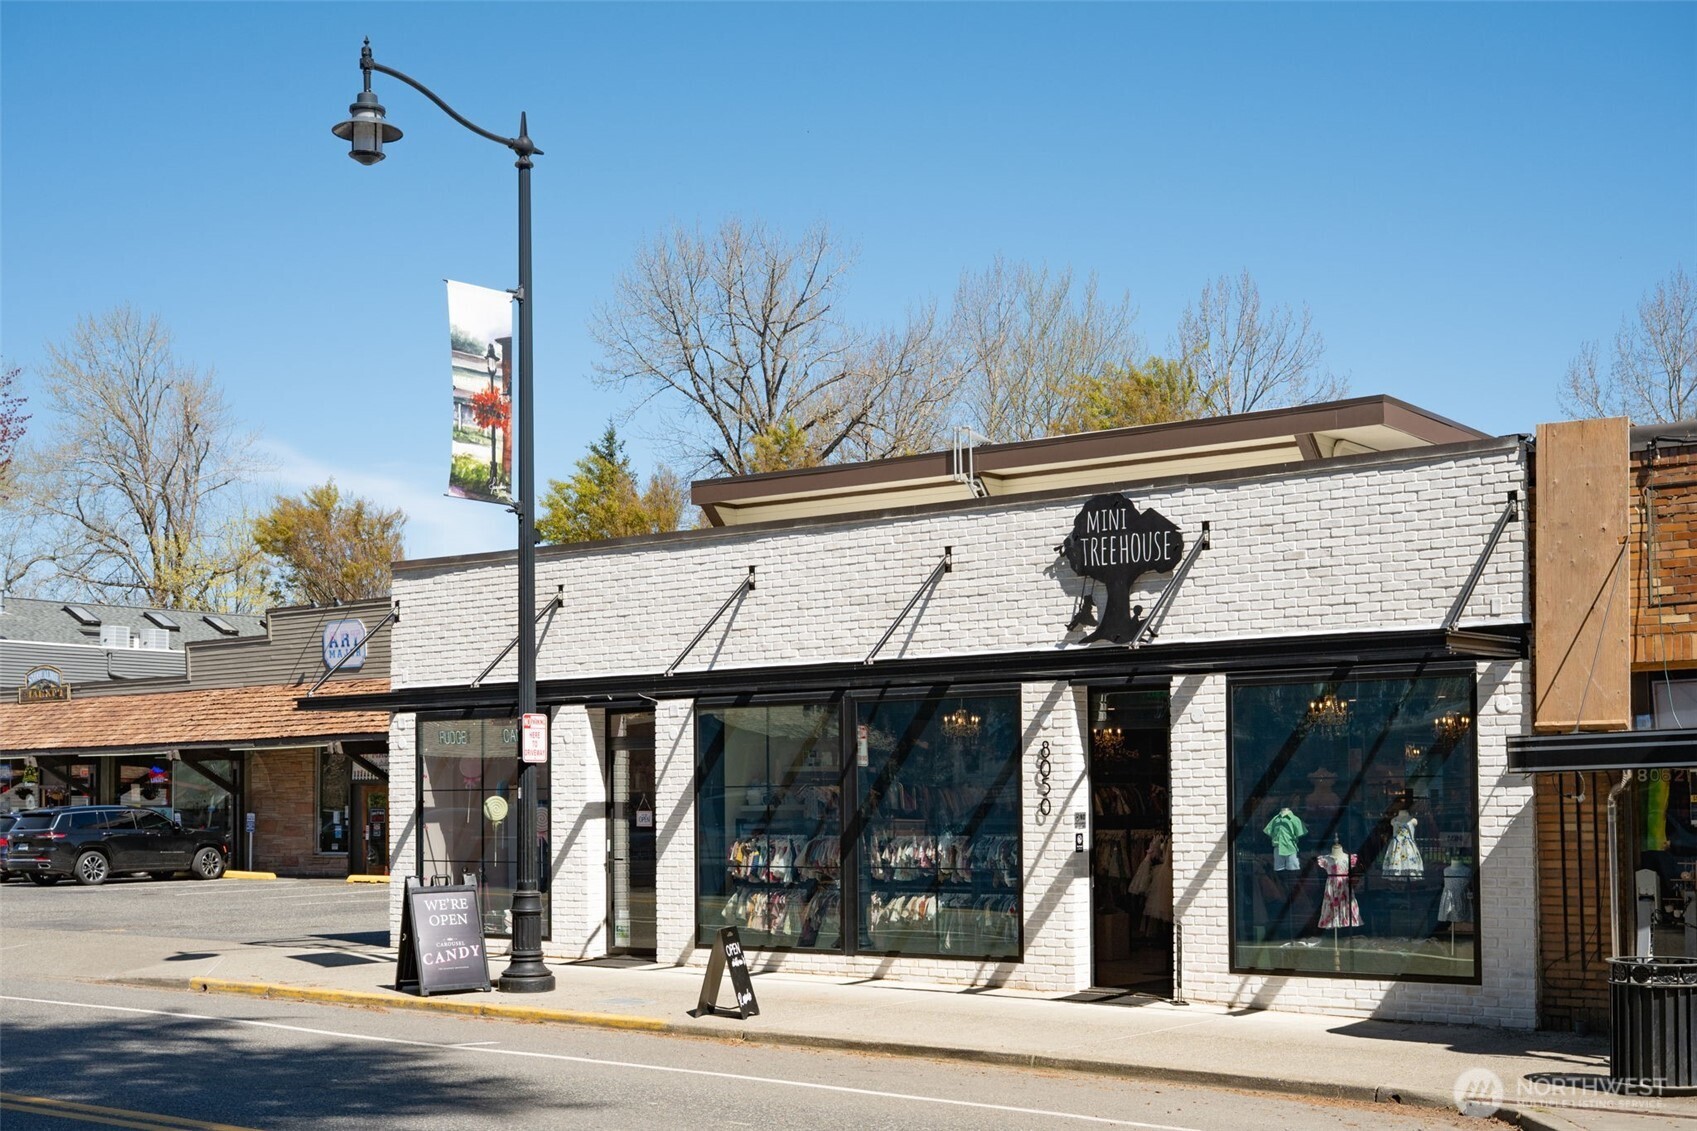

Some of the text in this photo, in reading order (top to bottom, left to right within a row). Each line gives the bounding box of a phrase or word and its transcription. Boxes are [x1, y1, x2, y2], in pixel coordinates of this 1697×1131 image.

[1086, 508, 1127, 533] MINI
[1080, 531, 1171, 567] TREEHOUSE
[329, 631, 360, 648] ART
[329, 648, 361, 659] MAJR
[439, 730, 467, 745] FUDGE
[1040, 740, 1051, 815] 8050
[638, 815, 651, 823] OPEN
[424, 898, 468, 911] WE'RE
[429, 913, 468, 927] OPEN
[422, 944, 480, 965] CANDY
[725, 942, 741, 957] OPEN
